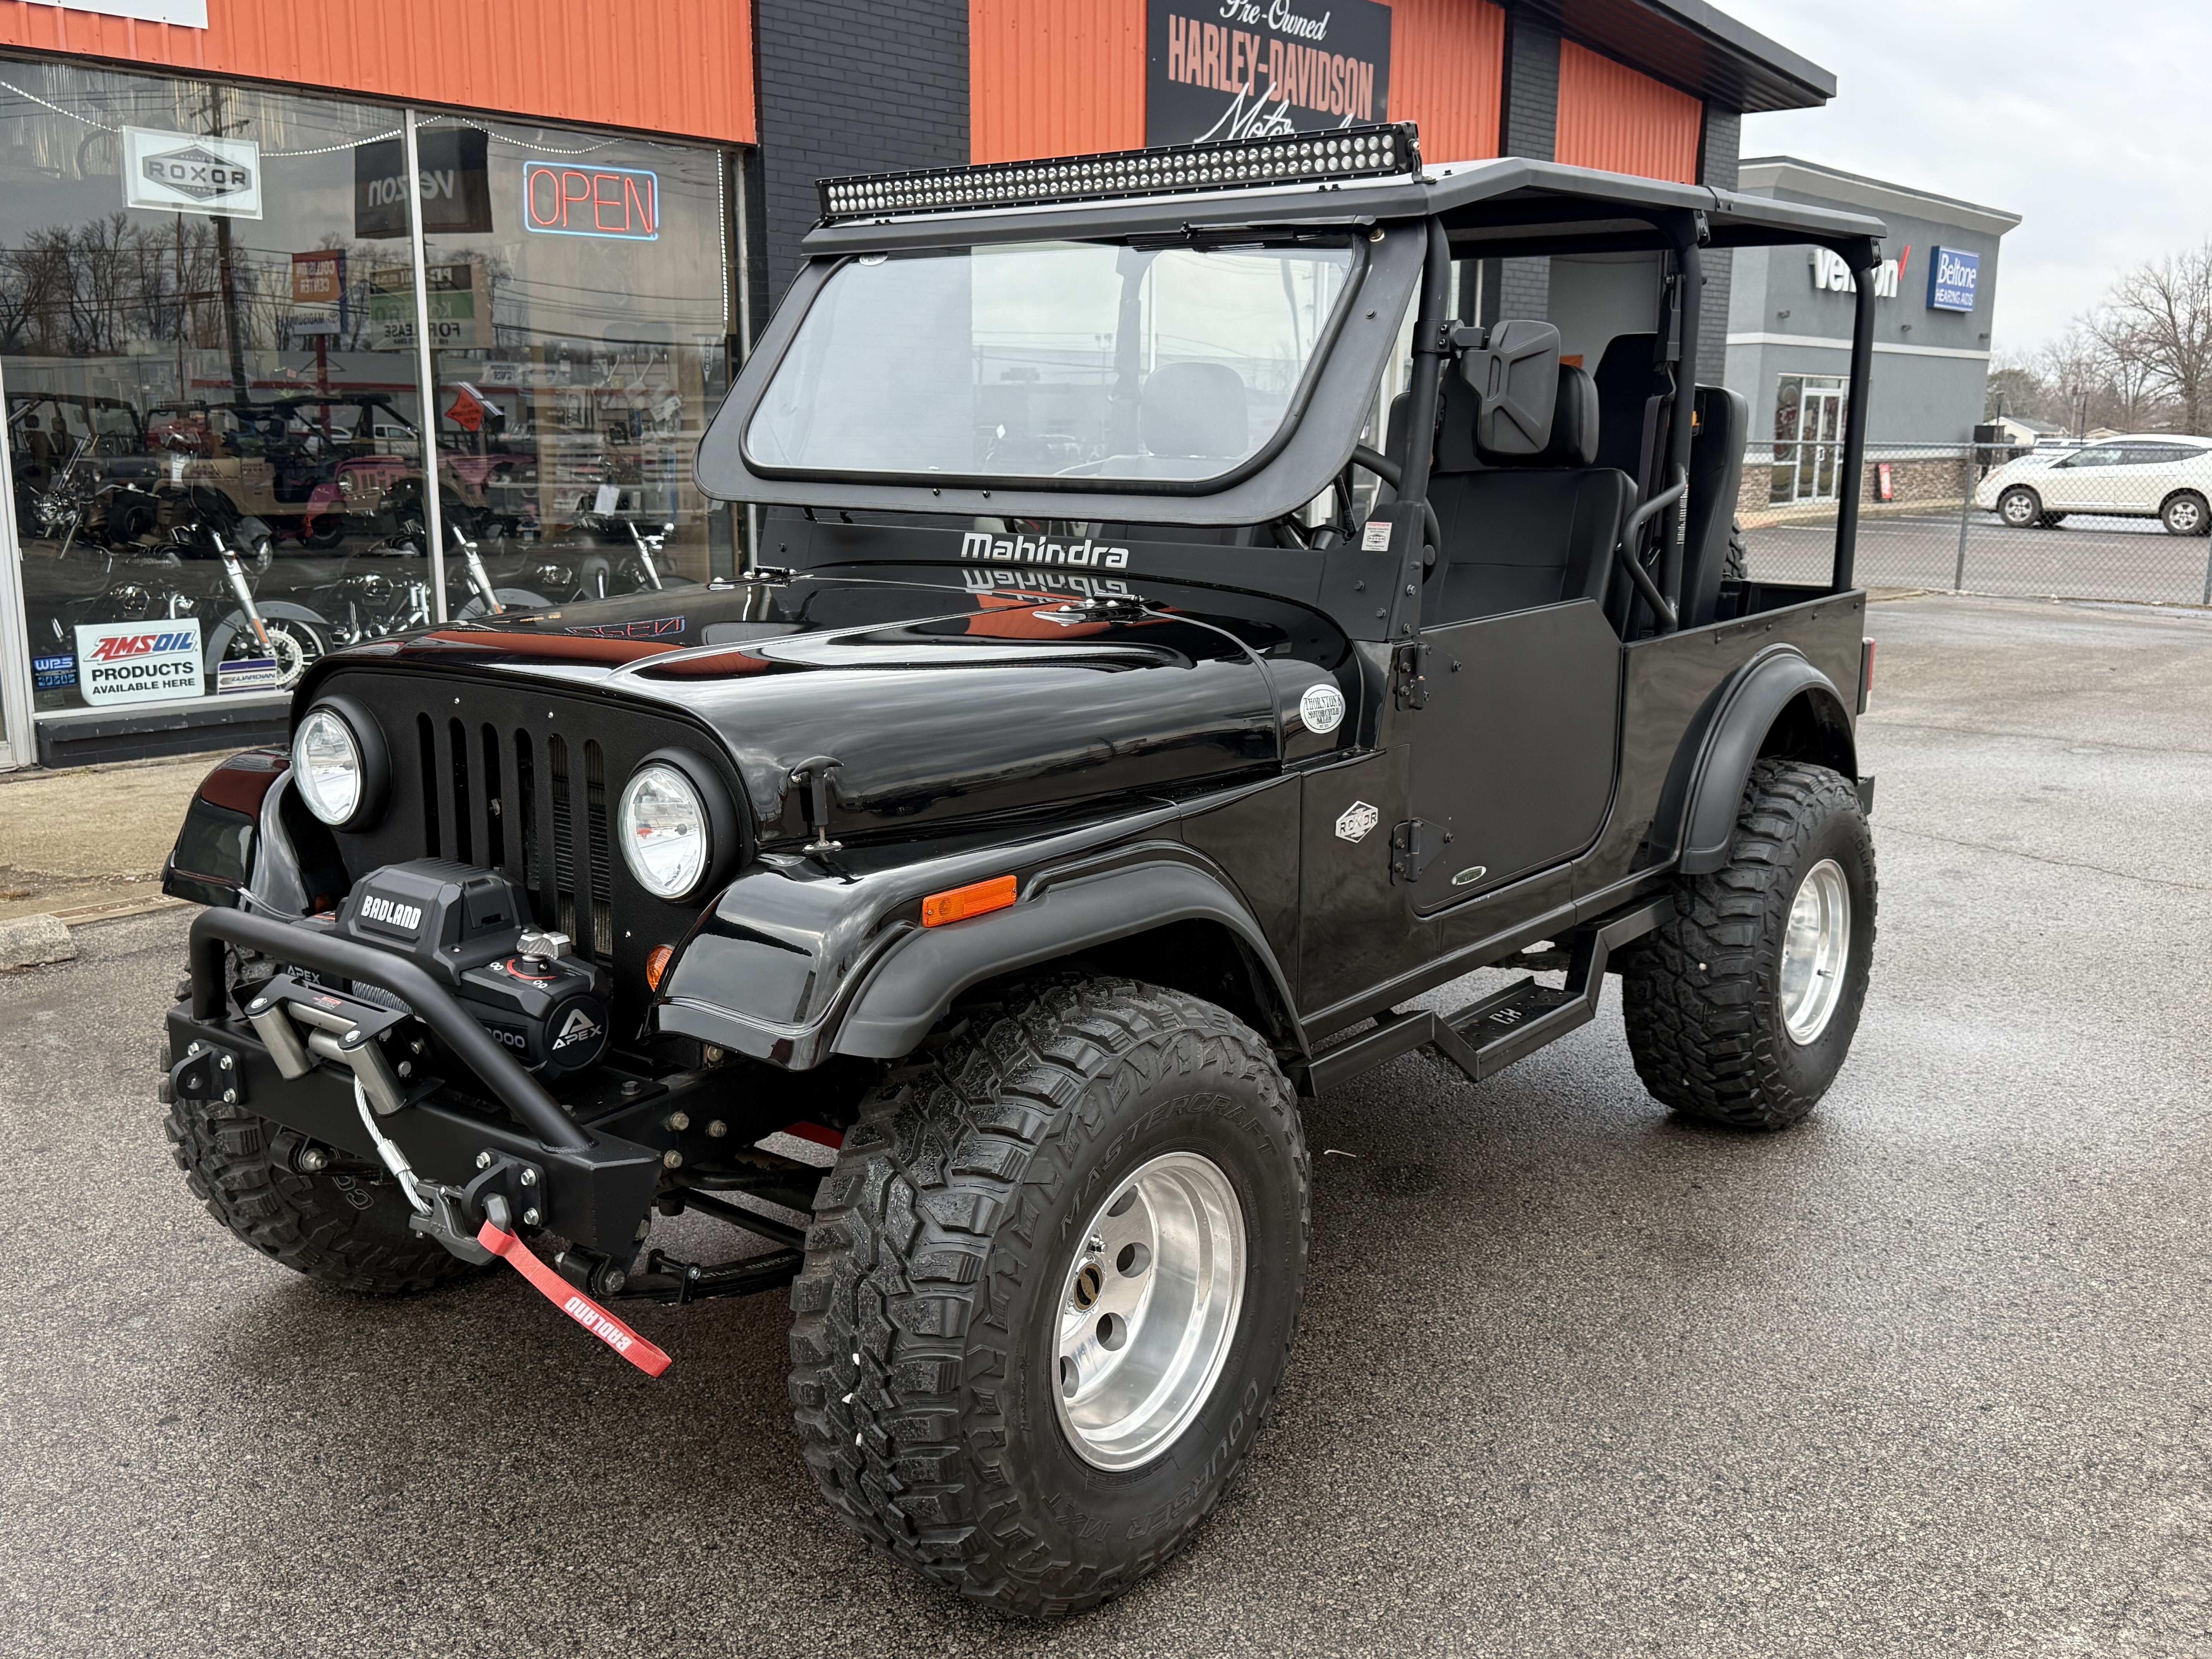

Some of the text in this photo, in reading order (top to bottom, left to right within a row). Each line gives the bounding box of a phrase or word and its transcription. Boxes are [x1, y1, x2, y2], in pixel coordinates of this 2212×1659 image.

[1168, 14, 1374, 121] HARLEY-DAVIDSON
[148, 161, 246, 185] ROXOR
[530, 169, 654, 233] OPEN
[1937, 253, 1977, 289] Beltone
[960, 532, 1129, 568] Mahindra
[90, 632, 193, 661] AMSOIL
[34, 656, 74, 670] WPS
[92, 661, 194, 682] PRODUCTS
[92, 678, 196, 695] AVAILABLE HERE
[361, 895, 422, 930] BADLAND
[287, 965, 321, 985] APEX
[552, 1025, 602, 1050] APEX
[1060, 1092, 1278, 1241] MASTERCRAFT
[564, 1296, 633, 1352] BADLAND
